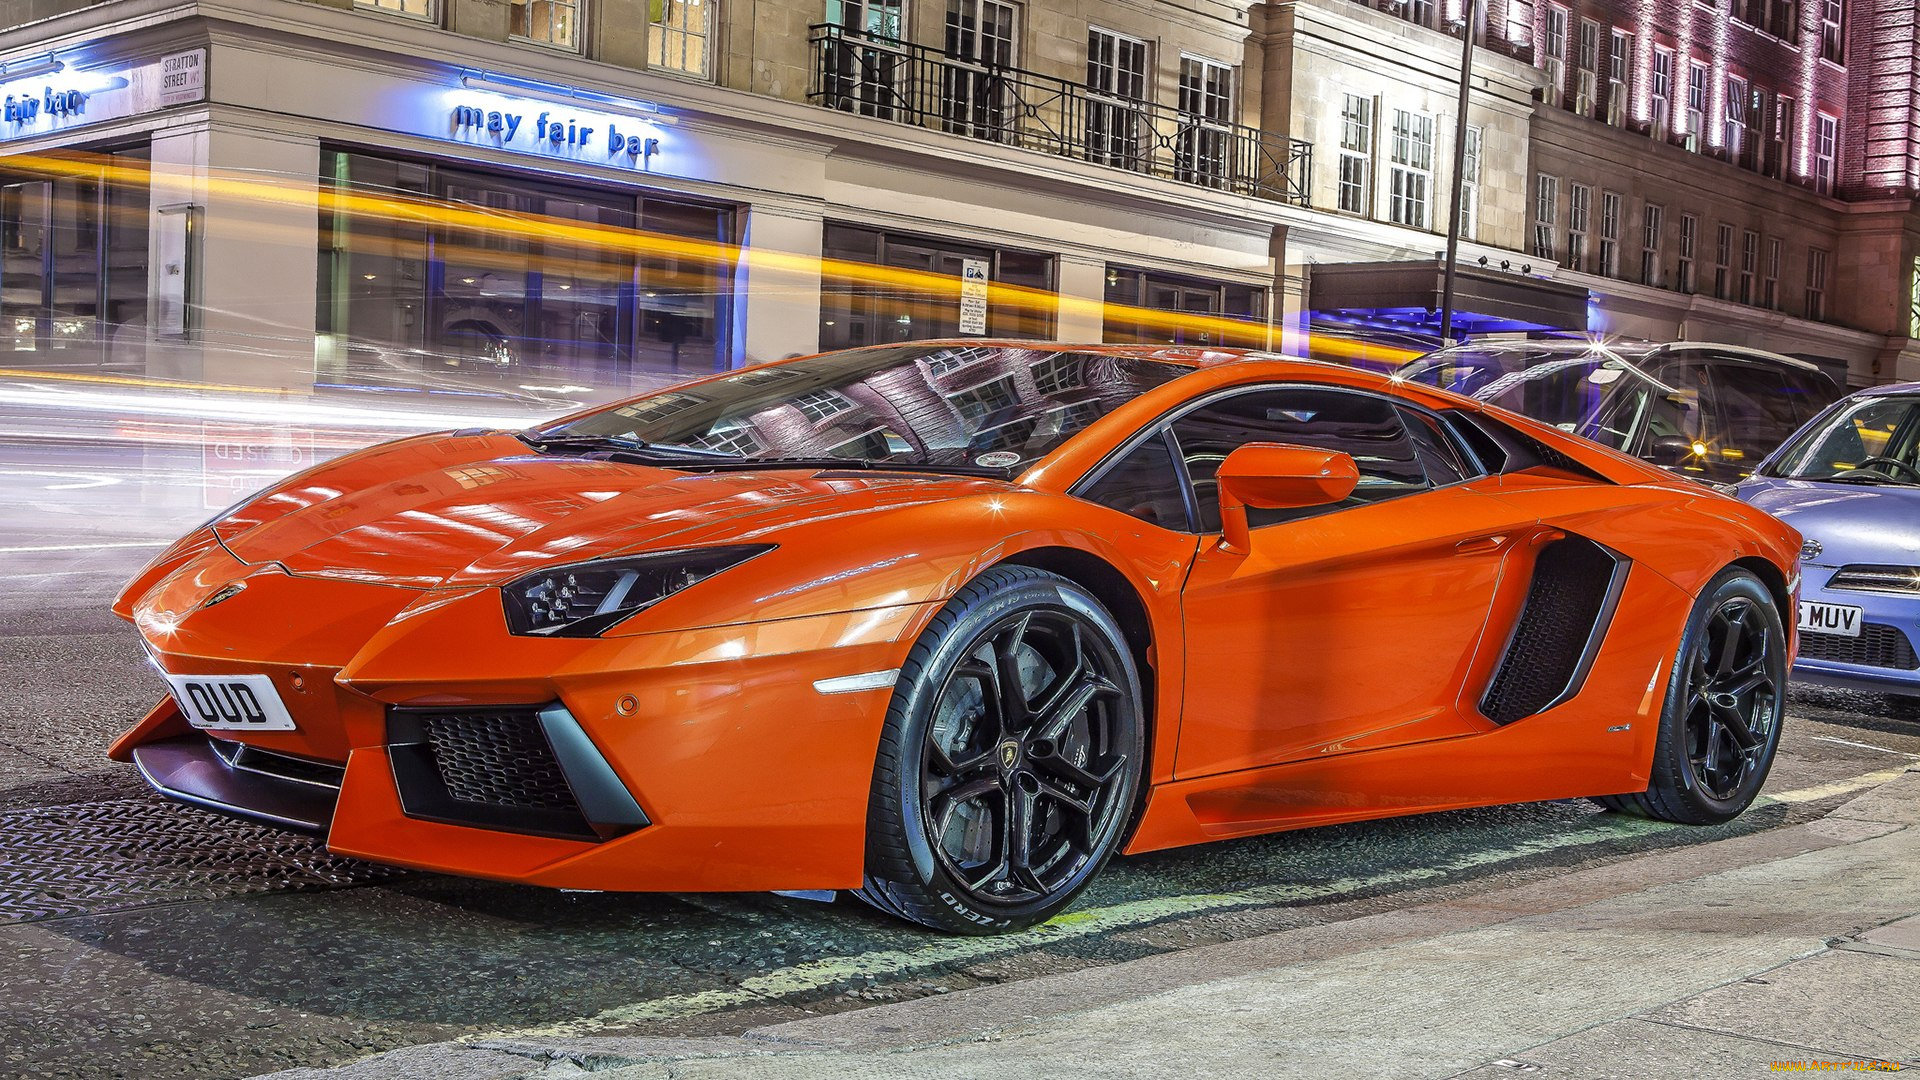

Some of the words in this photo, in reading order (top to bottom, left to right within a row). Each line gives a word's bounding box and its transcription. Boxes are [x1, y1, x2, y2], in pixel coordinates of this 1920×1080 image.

[164, 54, 198, 72] STRATTON
[164, 72, 188, 88] STREET
[4, 94, 40, 122] fair
[44, 86, 89, 116] bar
[455, 105, 523, 141] may
[537, 112, 593, 146] fair
[609, 123, 659, 156] bar
[1810, 606, 1856, 629] MUV
[185, 683, 267, 723] OUD
[940, 892, 994, 926] ZERO
